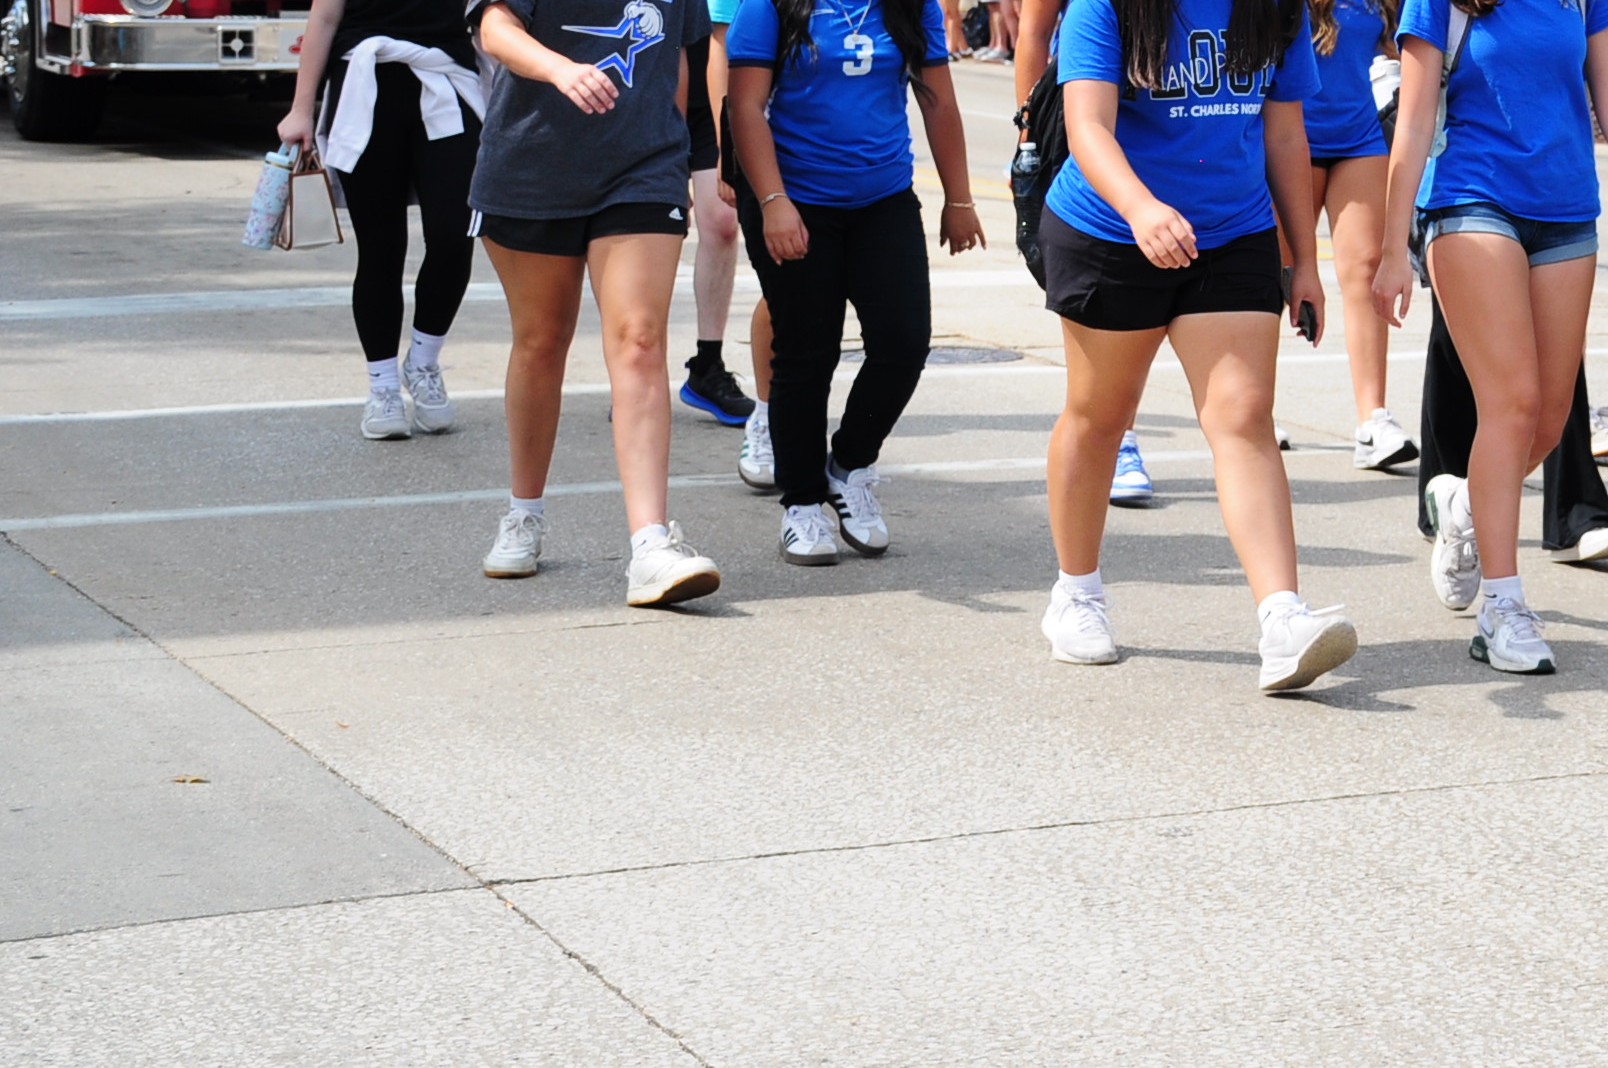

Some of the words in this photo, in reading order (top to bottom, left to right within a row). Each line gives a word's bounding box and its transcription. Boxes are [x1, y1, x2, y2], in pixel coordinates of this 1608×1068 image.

[842, 34, 875, 77] 3
[1169, 106, 1188, 118] ST.
[1190, 103, 1239, 118] CHARLES
[1240, 103, 1262, 115] NORT
